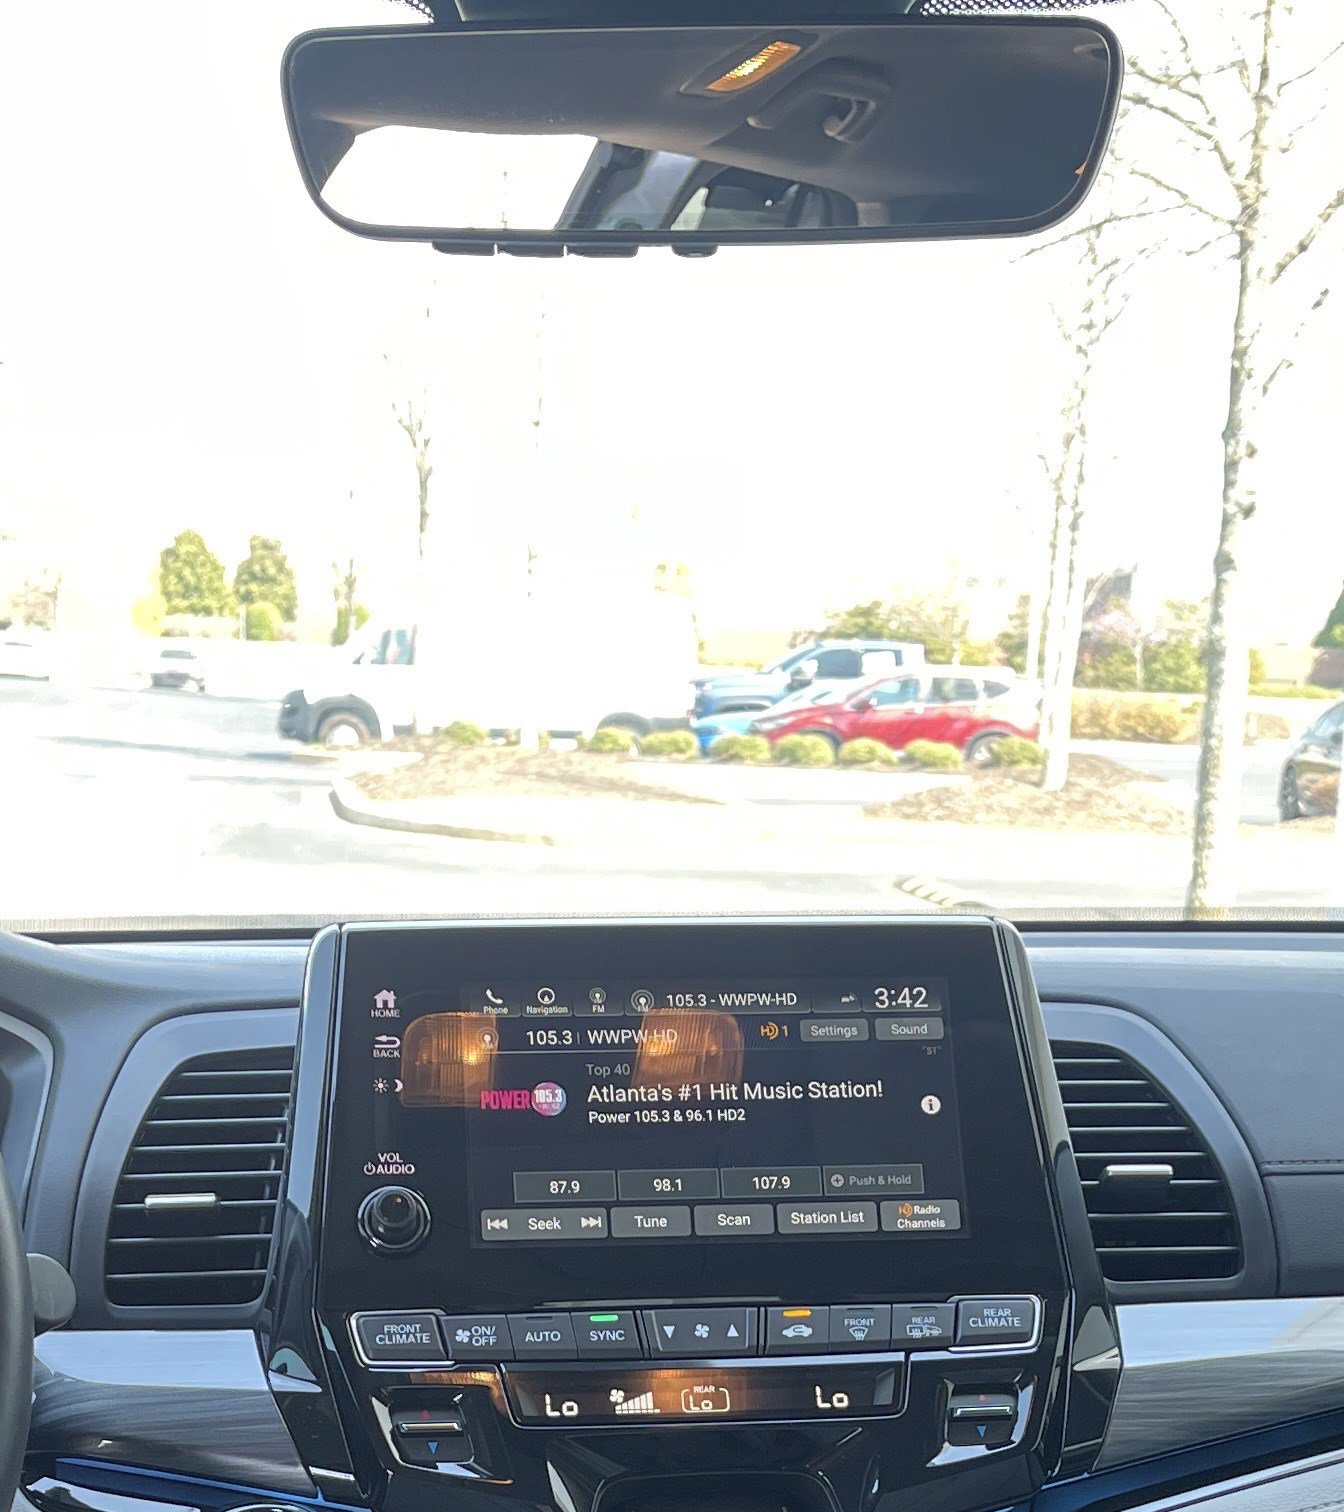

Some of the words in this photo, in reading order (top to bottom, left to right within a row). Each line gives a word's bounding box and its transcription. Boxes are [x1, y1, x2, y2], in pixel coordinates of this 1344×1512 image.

[666, 994, 707, 1007] 105.3
[718, 992, 797, 1006] WWPW-HD
[874, 986, 929, 1009] 3:42
[370, 1009, 401, 1018] HOME
[483, 1005, 508, 1015] Phone
[526, 1005, 568, 1015] Navigation
[592, 1004, 605, 1014] FM
[810, 1025, 858, 1038] Settings
[891, 1023, 928, 1035] Sound
[526, 1030, 573, 1045] 105.3
[373, 1049, 401, 1058] BACK
[585, 1063, 611, 1078] Top
[614, 1063, 631, 1075] 40
[587, 1083, 673, 1103] Atlanta's
[678, 1084, 701, 1101] #1
[710, 1083, 738, 1101] Hit
[743, 1081, 804, 1100] Music
[808, 1079, 884, 1099] Station!
[480, 1089, 531, 1110] POWER
[588, 1110, 631, 1123] Power
[633, 1110, 670, 1122] 105.3
[673, 1110, 683, 1122] &
[685, 1109, 713, 1122] 96.1
[717, 1108, 746, 1121] HD2
[378, 1153, 403, 1163] VOL
[376, 1164, 416, 1175] AUDIO
[653, 1178, 682, 1191] 98.1
[752, 1176, 791, 1190] 107.9
[849, 1175, 876, 1186] Push
[878, 1175, 885, 1185] &
[888, 1174, 912, 1185] Hold
[549, 1181, 580, 1194] 87.9
[914, 1205, 941, 1214] Radio
[528, 1217, 562, 1230] Seek
[634, 1215, 668, 1228] Tune
[717, 1213, 751, 1227] Scan
[790, 1211, 838, 1225] Station
[840, 1210, 865, 1224] List
[897, 1218, 946, 1228] Channels
[983, 1308, 1012, 1318] REAR
[844, 1318, 875, 1327] FRONT
[912, 1316, 936, 1324] REAR
[969, 1316, 1022, 1328] CLIMATE
[384, 1324, 421, 1334] FRONT
[472, 1326, 496, 1336] ON/
[376, 1333, 431, 1345] CLIMATE
[472, 1336, 497, 1346] OFF
[525, 1331, 561, 1342] AUTO
[589, 1330, 625, 1341] SYNC
[693, 1385, 715, 1393] REAR
[689, 1394, 713, 1410] Lo
[815, 1385, 849, 1409] Lo
[545, 1393, 578, 1417] Lo
